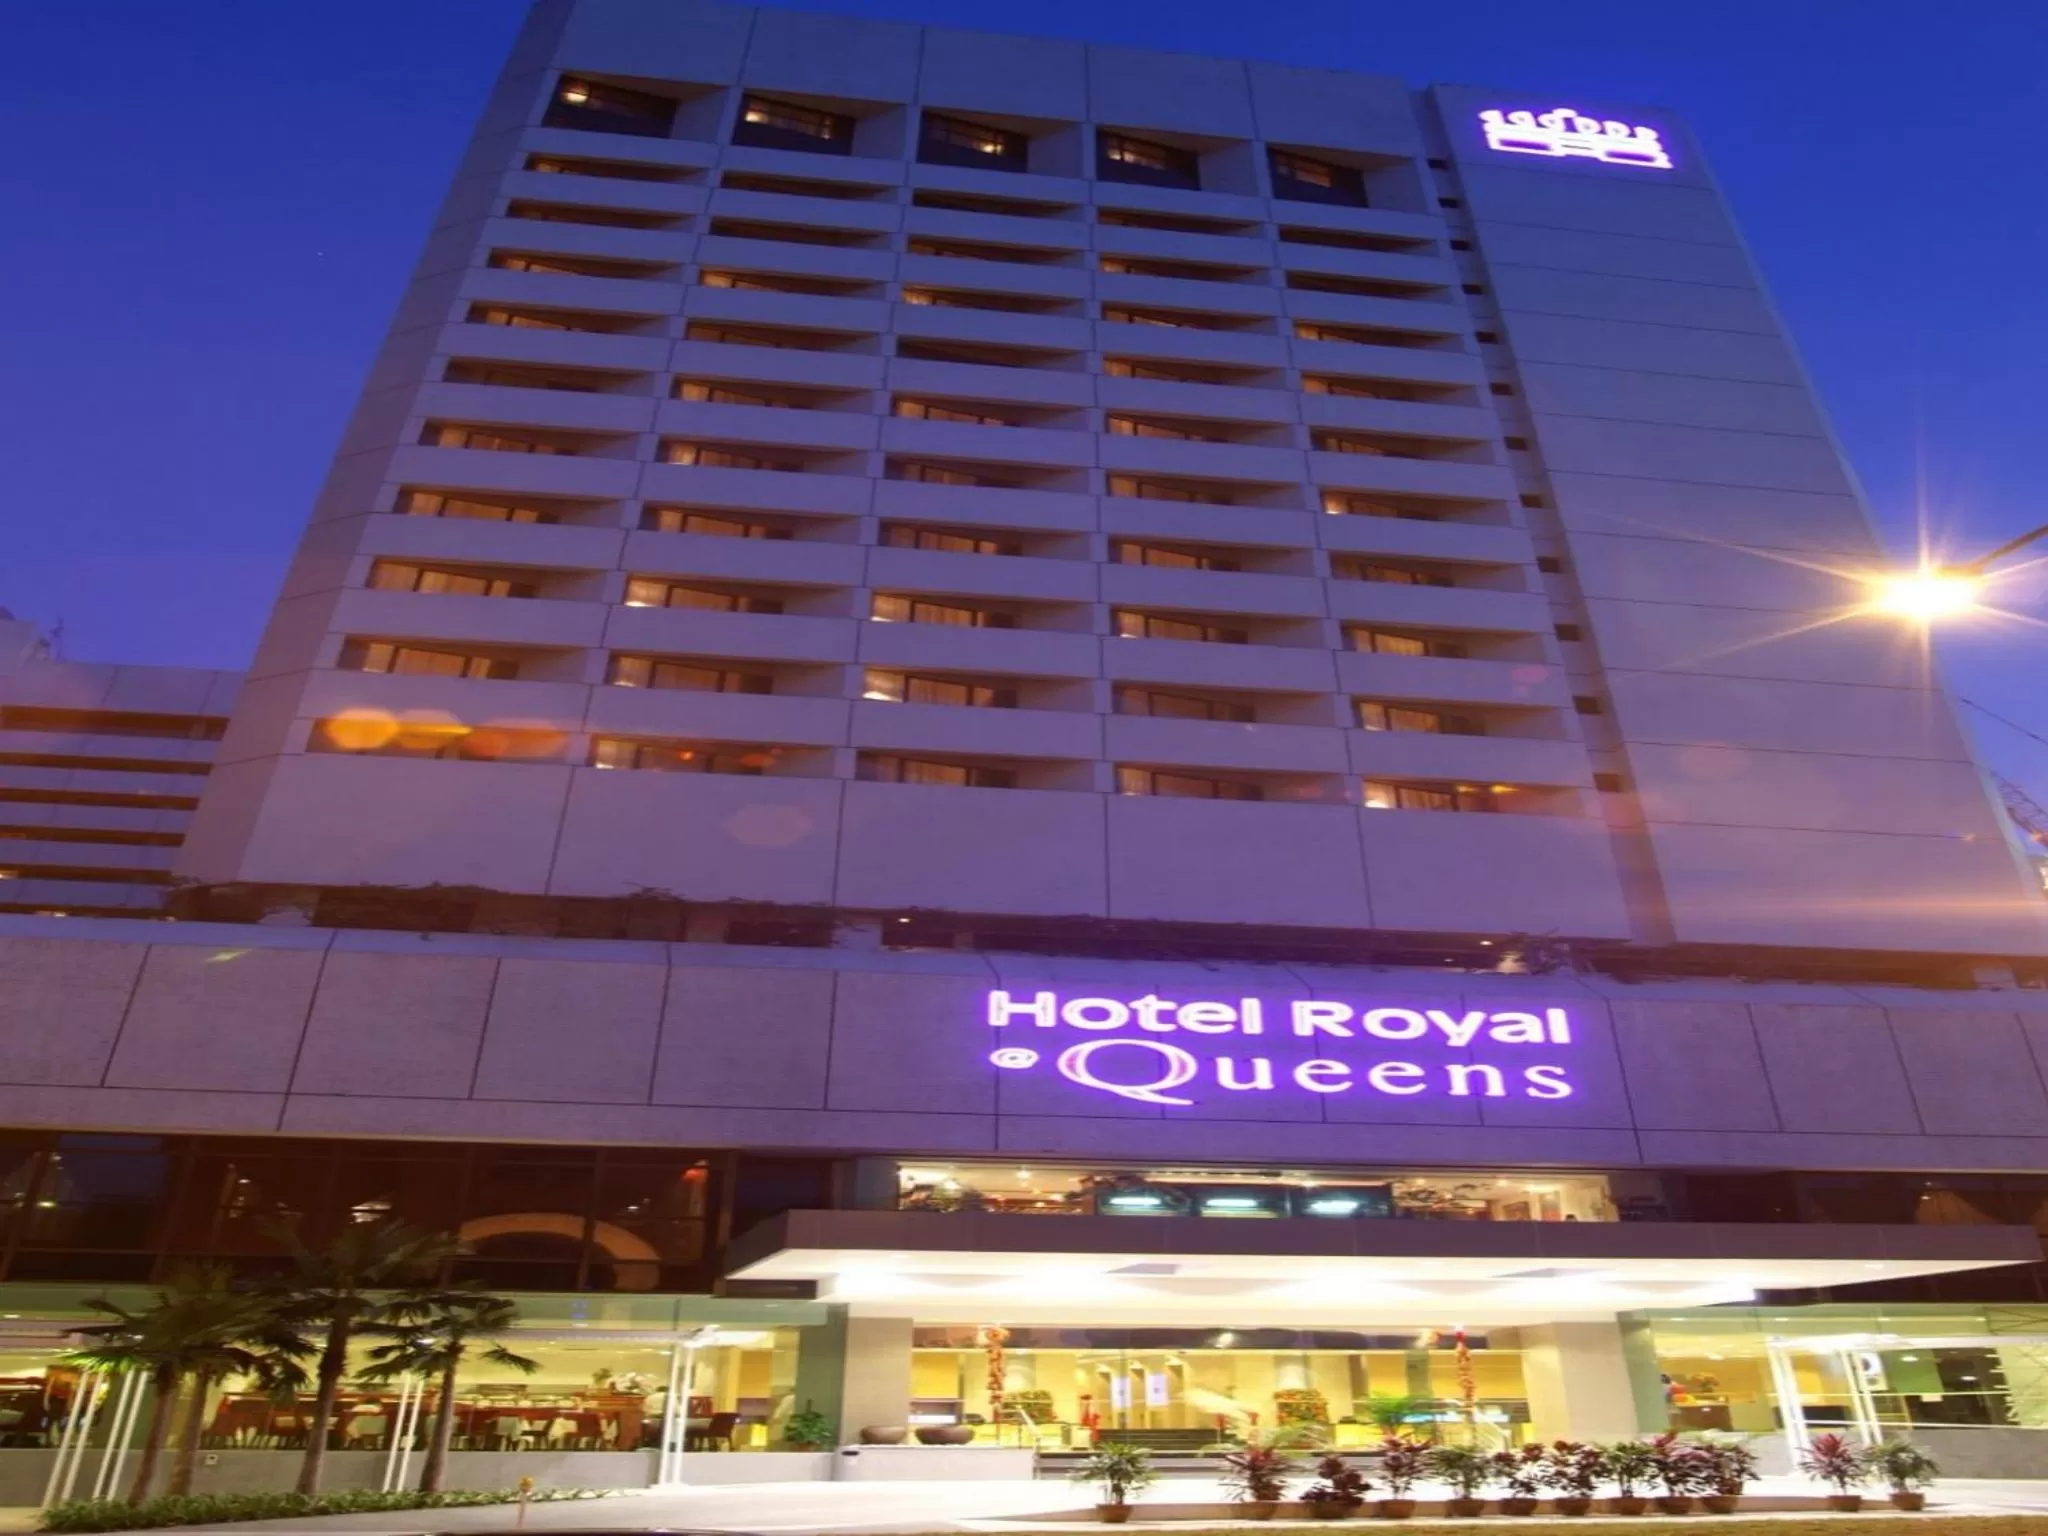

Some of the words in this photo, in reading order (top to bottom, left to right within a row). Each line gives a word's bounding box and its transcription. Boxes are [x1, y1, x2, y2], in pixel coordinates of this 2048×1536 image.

[987, 990, 1264, 1036] Hotel
[1291, 1000, 1572, 1047] Royal
[989, 1047, 1039, 1069] @
[1057, 1038, 1573, 1106] Queens
